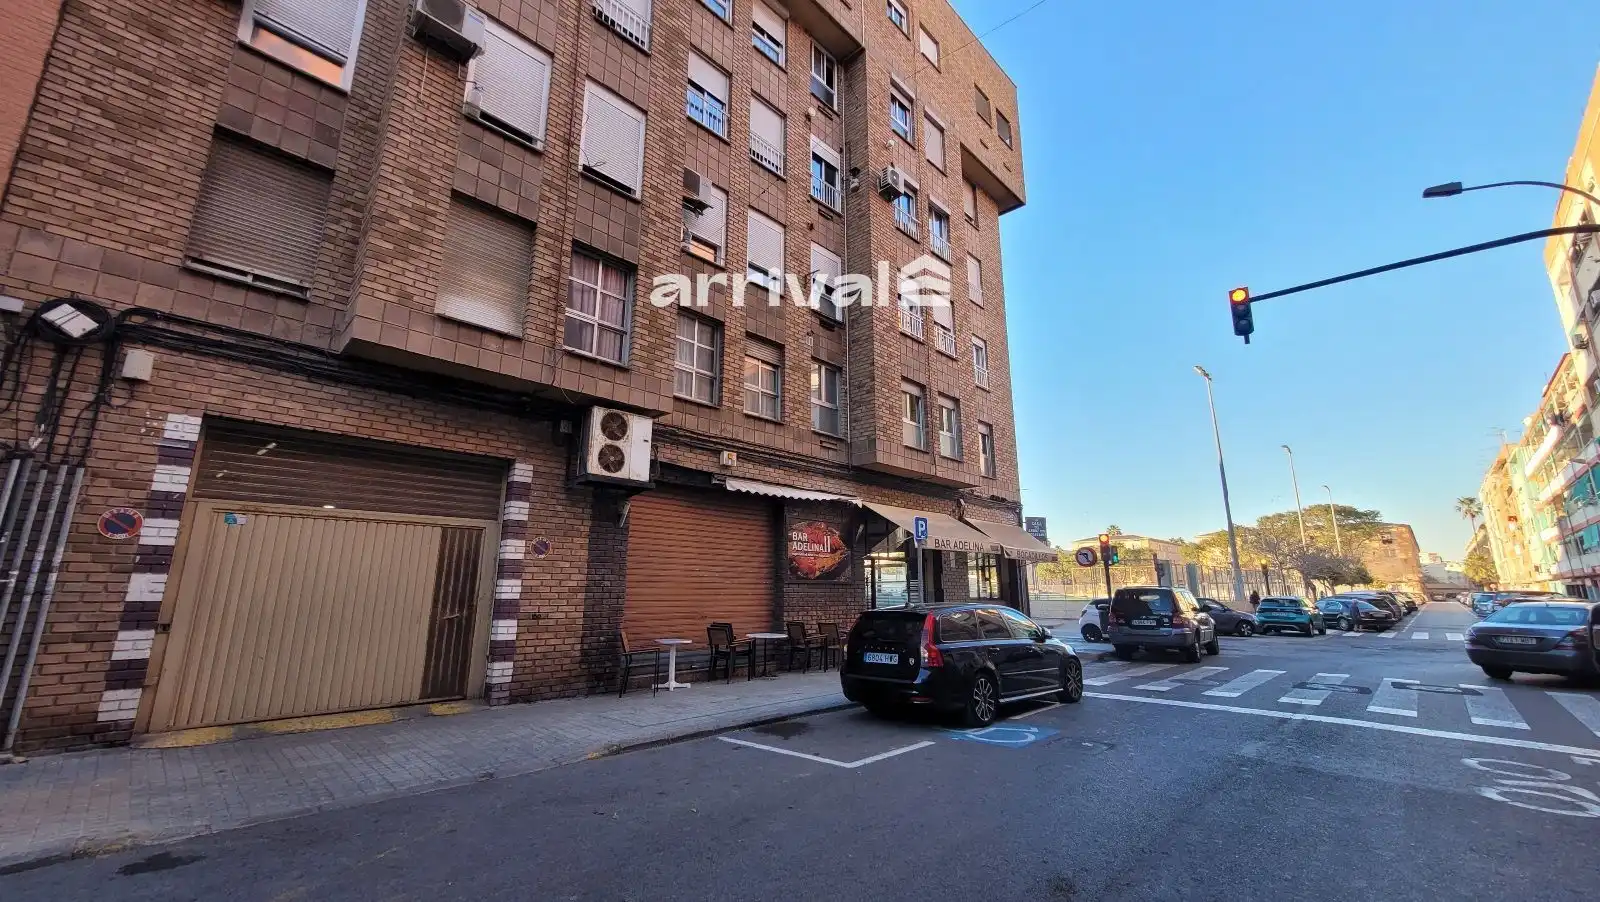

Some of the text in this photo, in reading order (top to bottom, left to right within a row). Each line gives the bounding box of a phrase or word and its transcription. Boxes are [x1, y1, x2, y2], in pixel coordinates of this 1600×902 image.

[918, 520, 926, 537] P
[792, 531, 808, 541] BAR
[792, 541, 824, 552] ADELINA
[934, 538, 984, 552] BAR ADELINA
